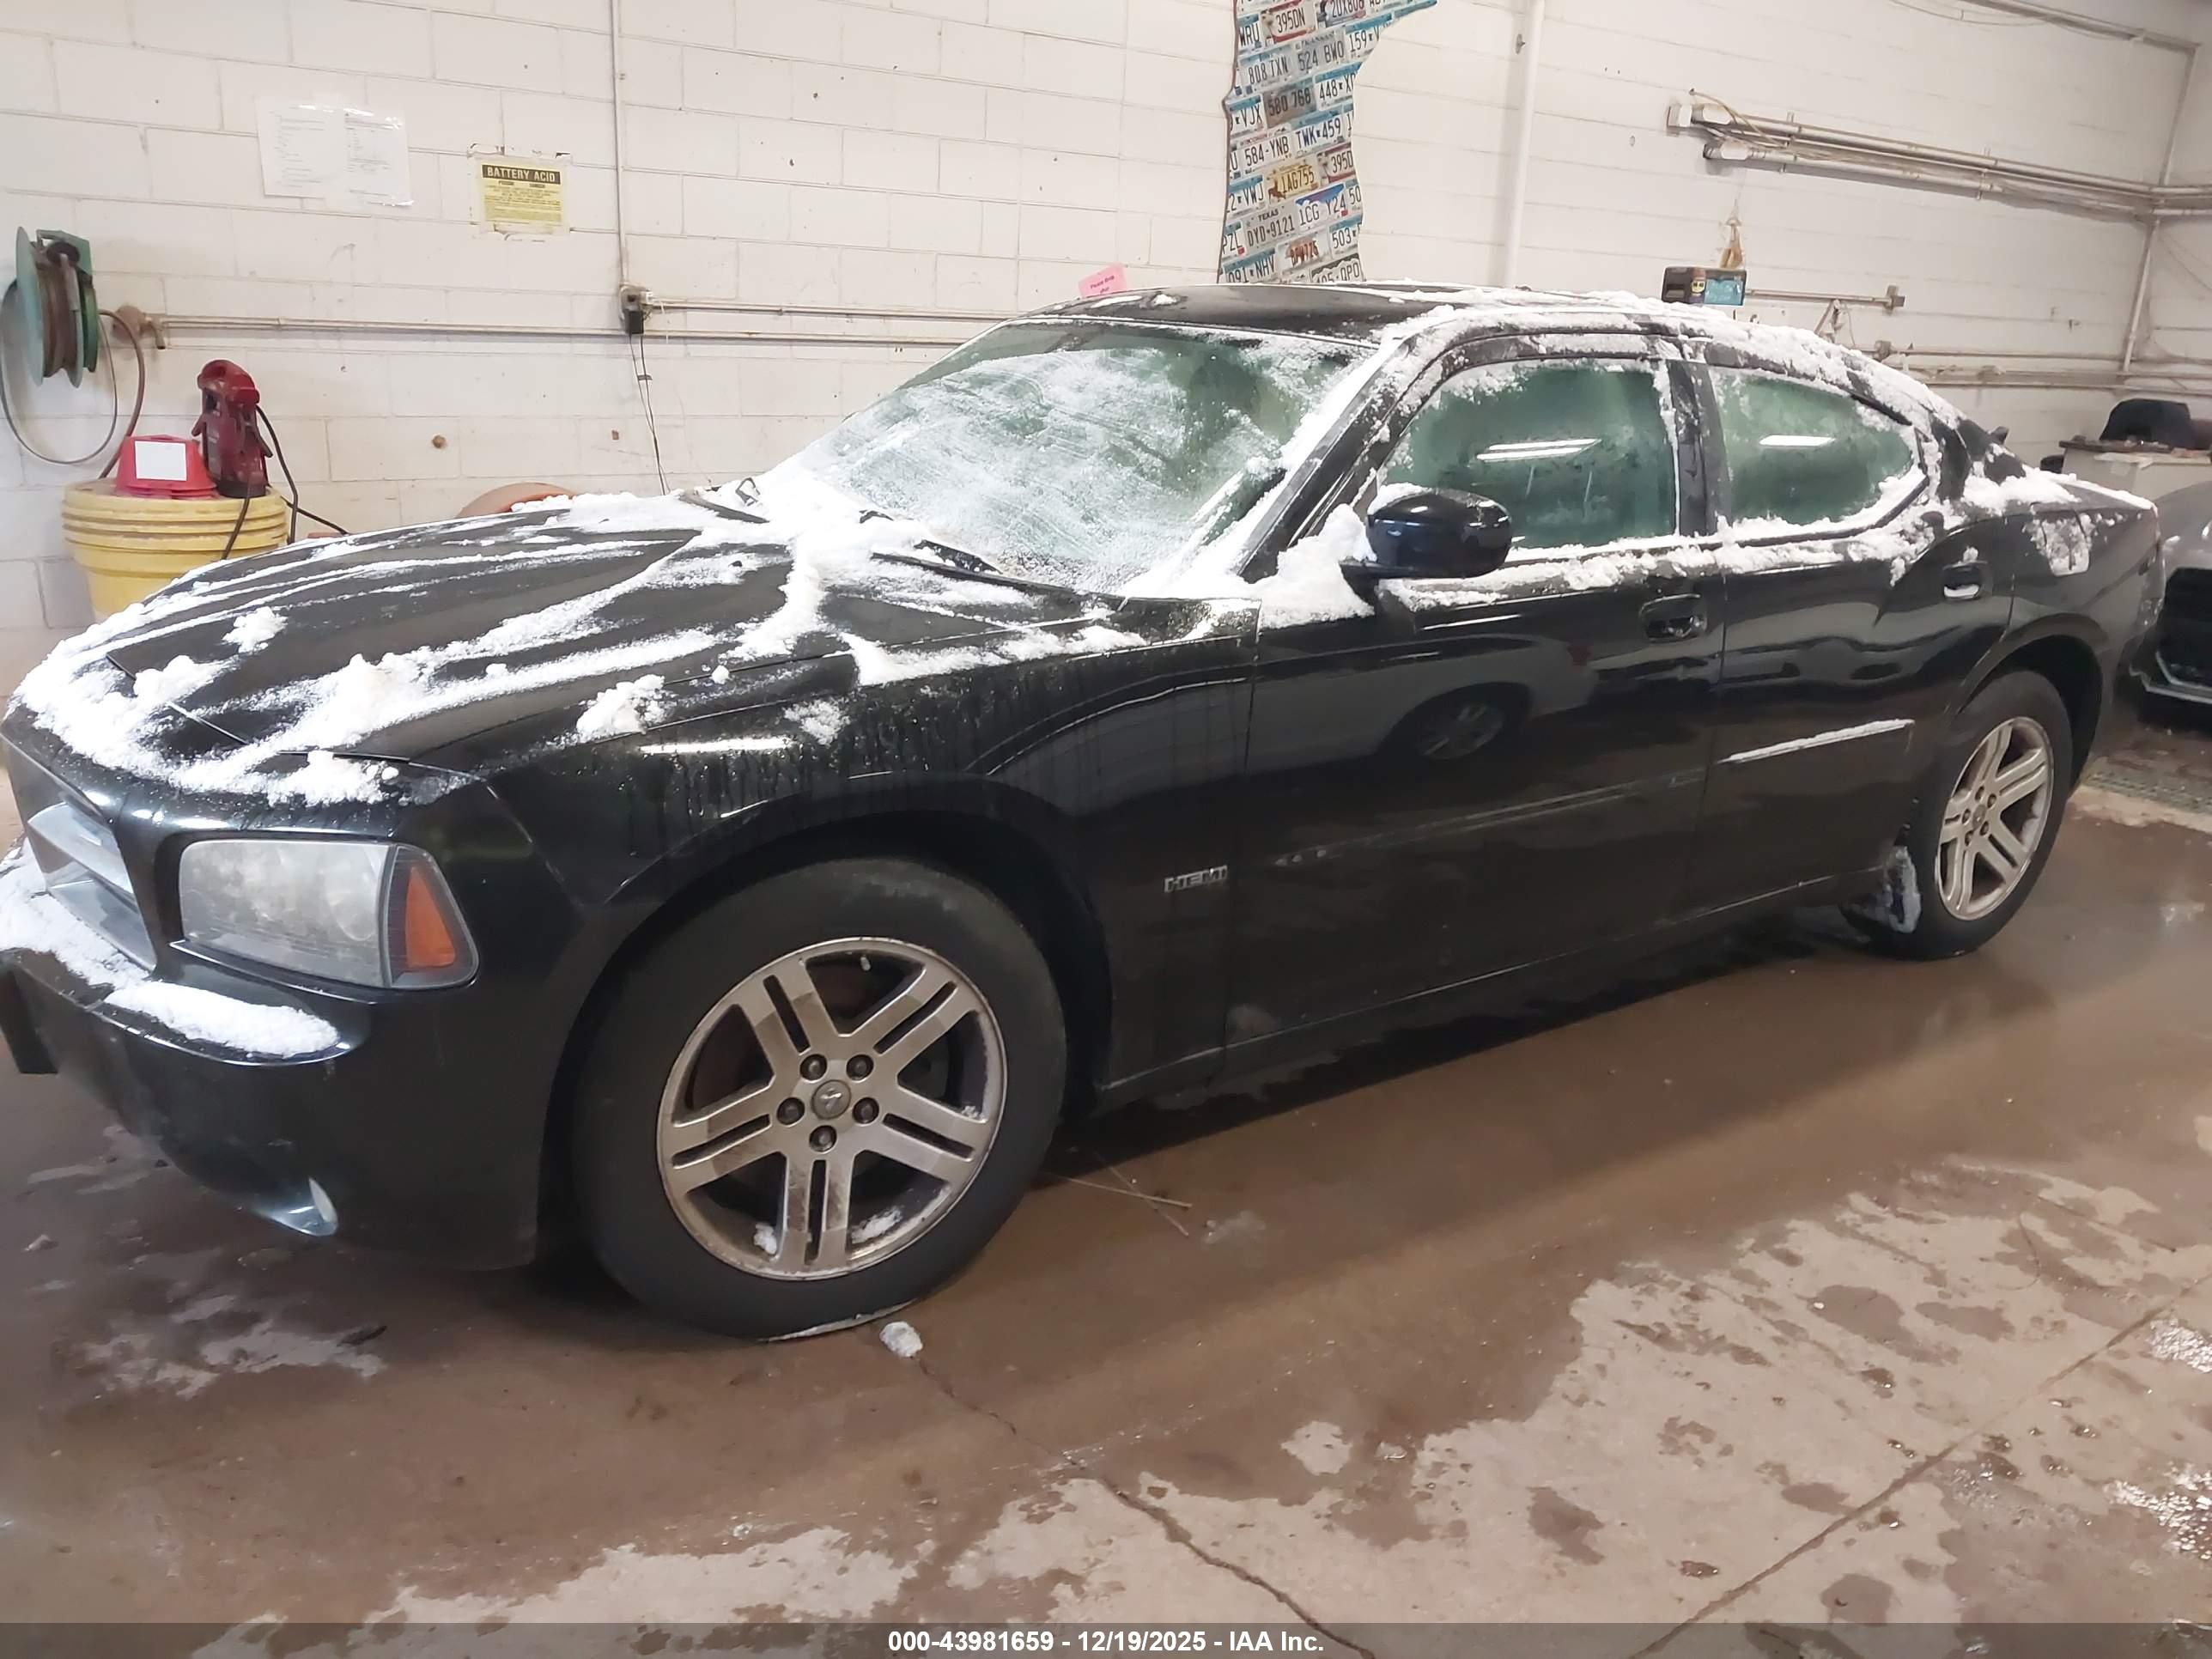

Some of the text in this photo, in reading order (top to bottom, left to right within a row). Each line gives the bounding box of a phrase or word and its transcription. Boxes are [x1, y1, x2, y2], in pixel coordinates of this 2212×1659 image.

[486, 166, 556, 183] BATTERY ACID
[1258, 208, 1279, 222] TEXAS
[1164, 864, 1229, 893] HEMI
